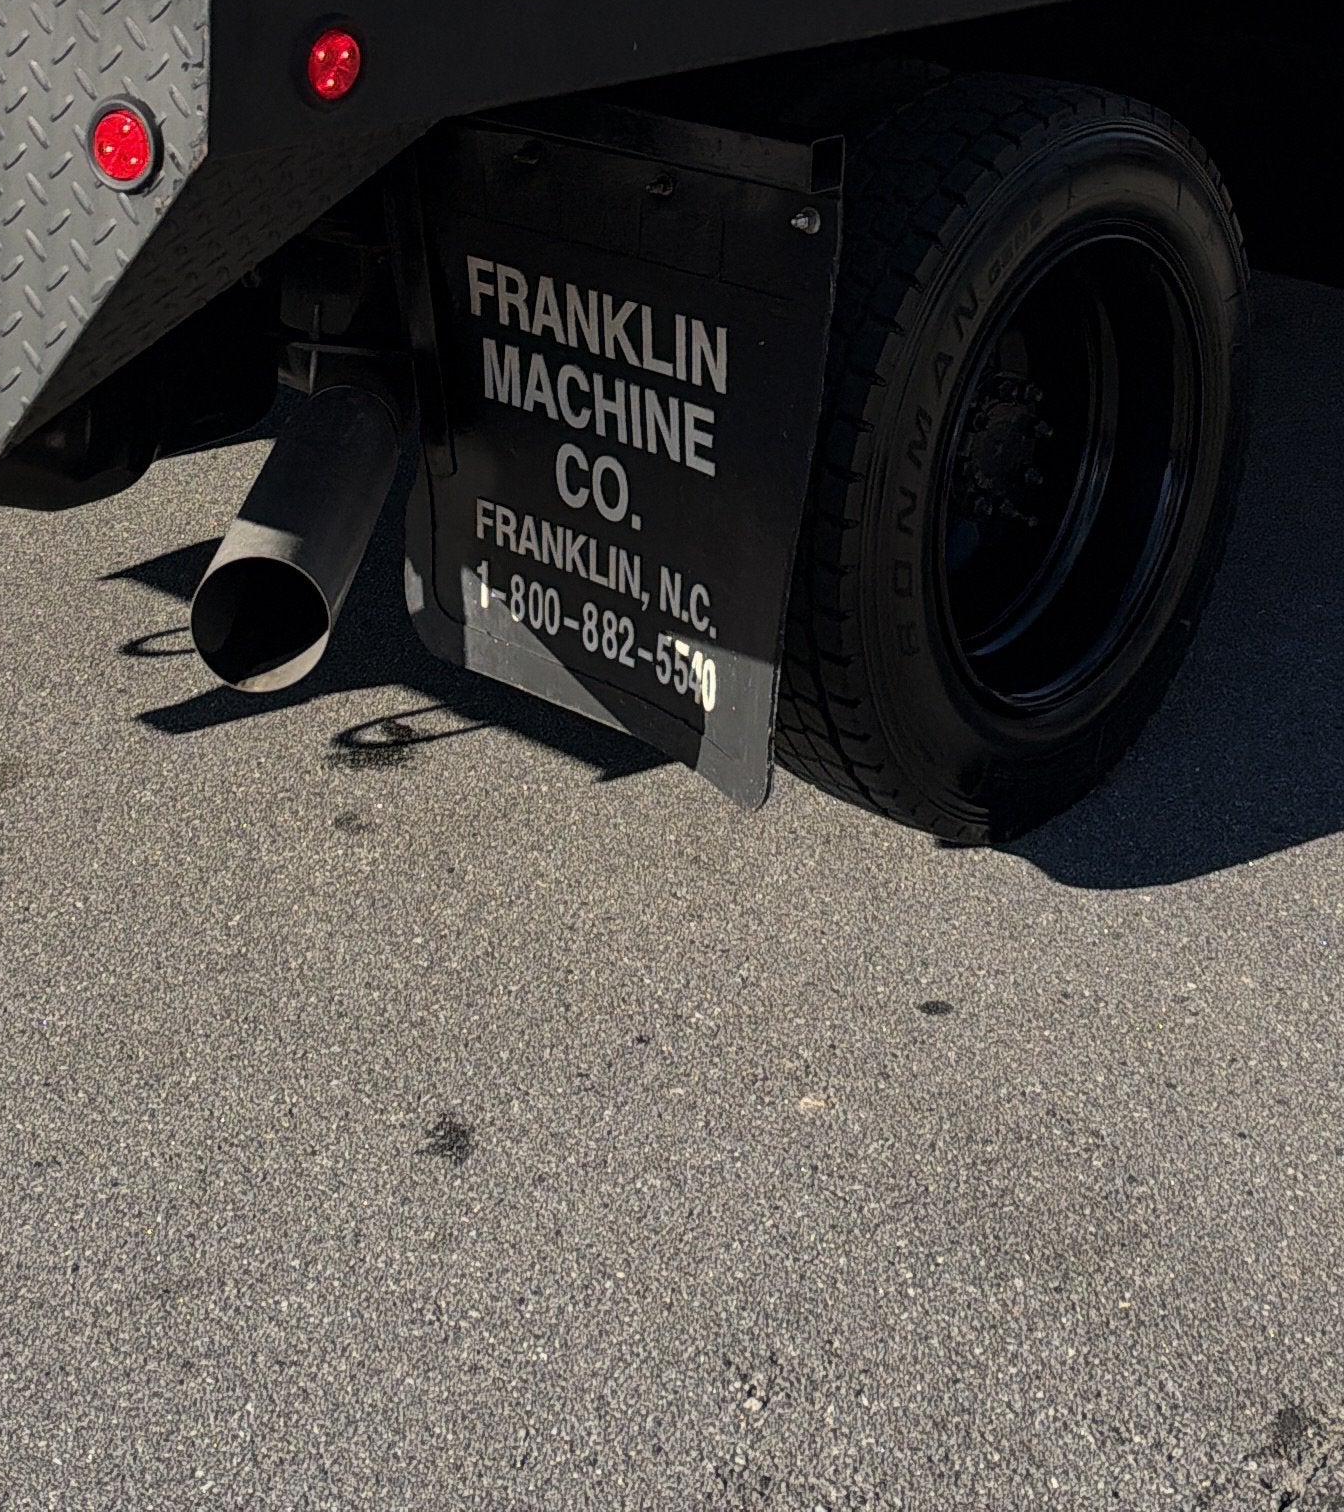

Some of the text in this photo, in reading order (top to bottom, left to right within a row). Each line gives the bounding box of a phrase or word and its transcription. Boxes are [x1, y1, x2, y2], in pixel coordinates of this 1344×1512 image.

[467, 255, 728, 395] FRANKLIN
[483, 337, 715, 477] MACHINE
[556, 443, 641, 531] CO.
[476, 497, 717, 639] FRANKLIN, N.C.
[476, 559, 717, 713] 1-800-882-5540
